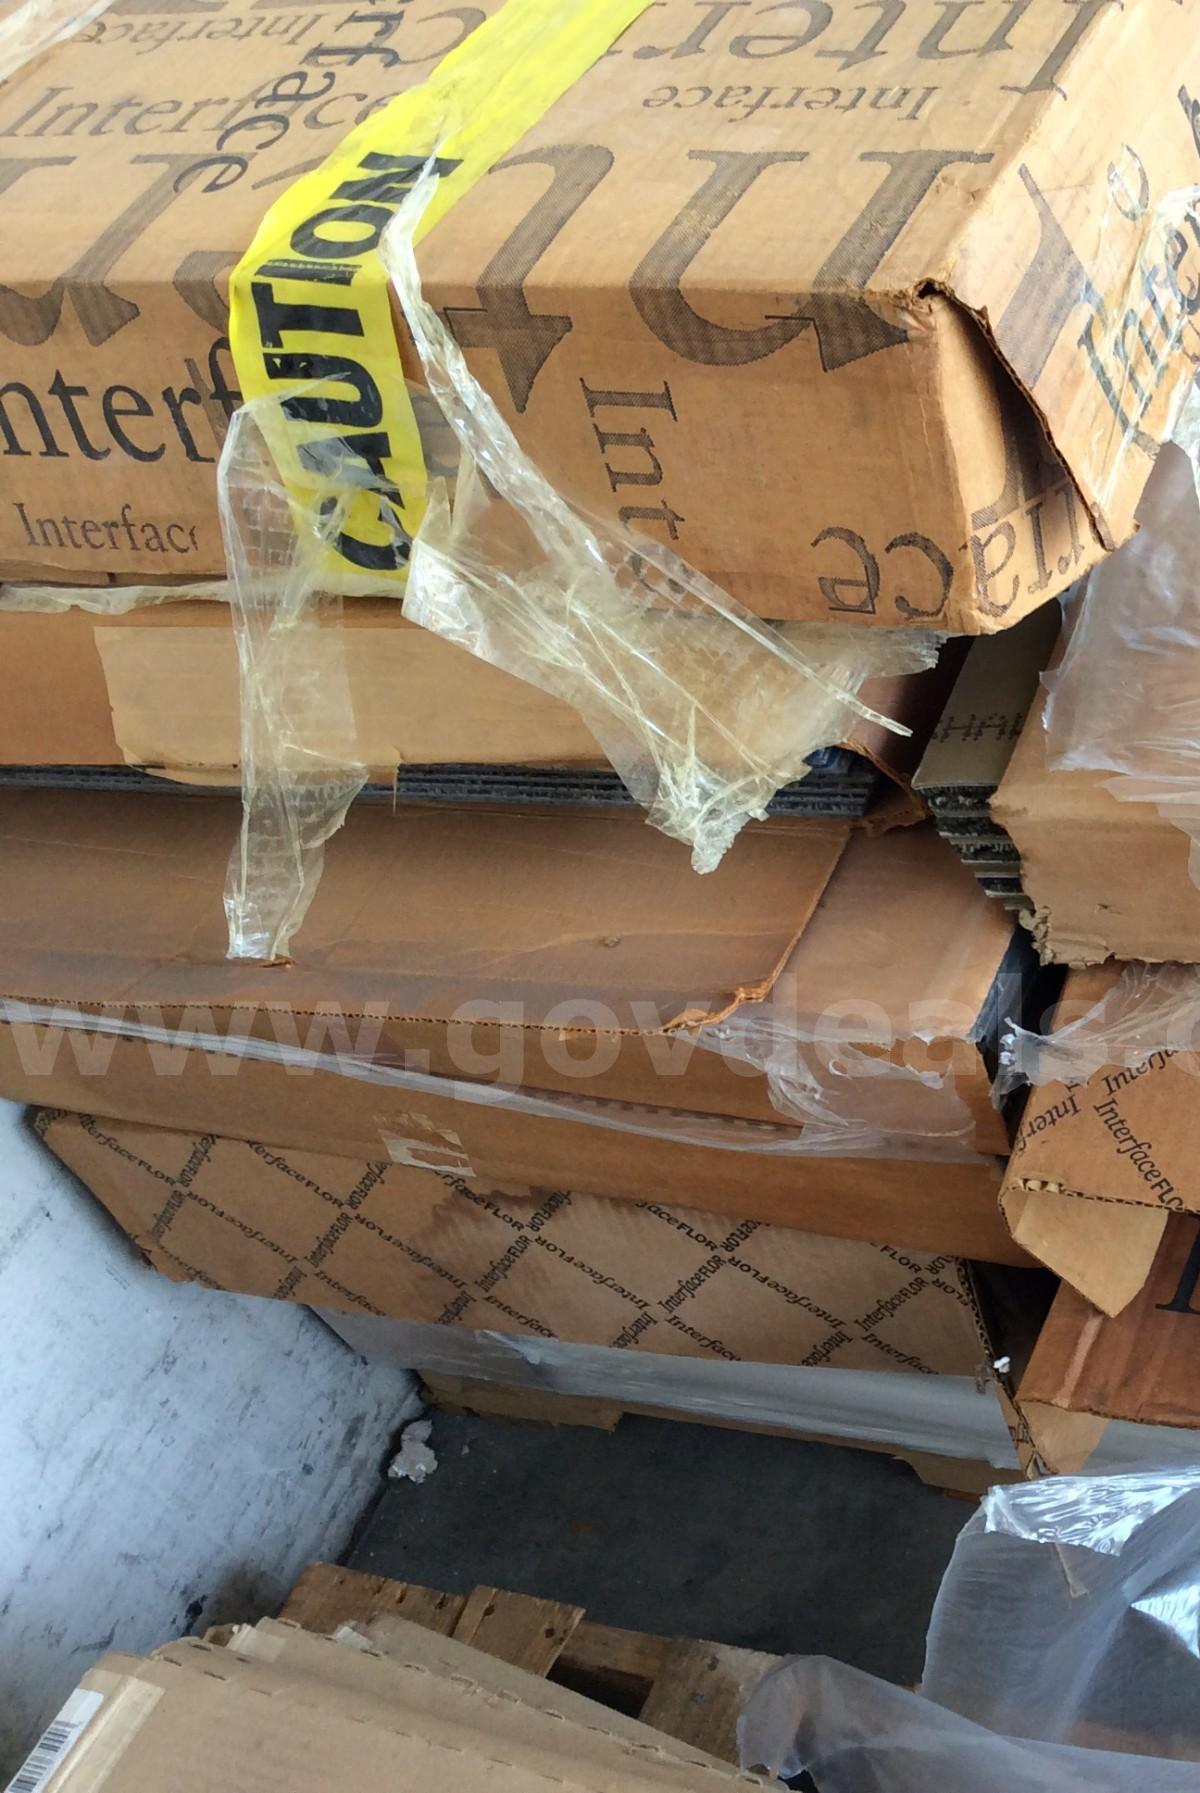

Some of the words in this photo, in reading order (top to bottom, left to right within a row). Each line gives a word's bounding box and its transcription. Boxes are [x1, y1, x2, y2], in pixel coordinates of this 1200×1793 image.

[641, 86, 944, 121] Interface
[250, 151, 464, 571] CAUTION
[185, 1188, 299, 1265] InterfaceFLOR
[473, 1234, 534, 1294] InterfaceFLOR
[533, 1234, 653, 1311] InterfaceFLOR
[656, 1253, 728, 1314] InterfaceFLOR
[727, 1255, 848, 1330] InterfaceFLOR
[853, 1275, 931, 1332] InterfaceFLOR
